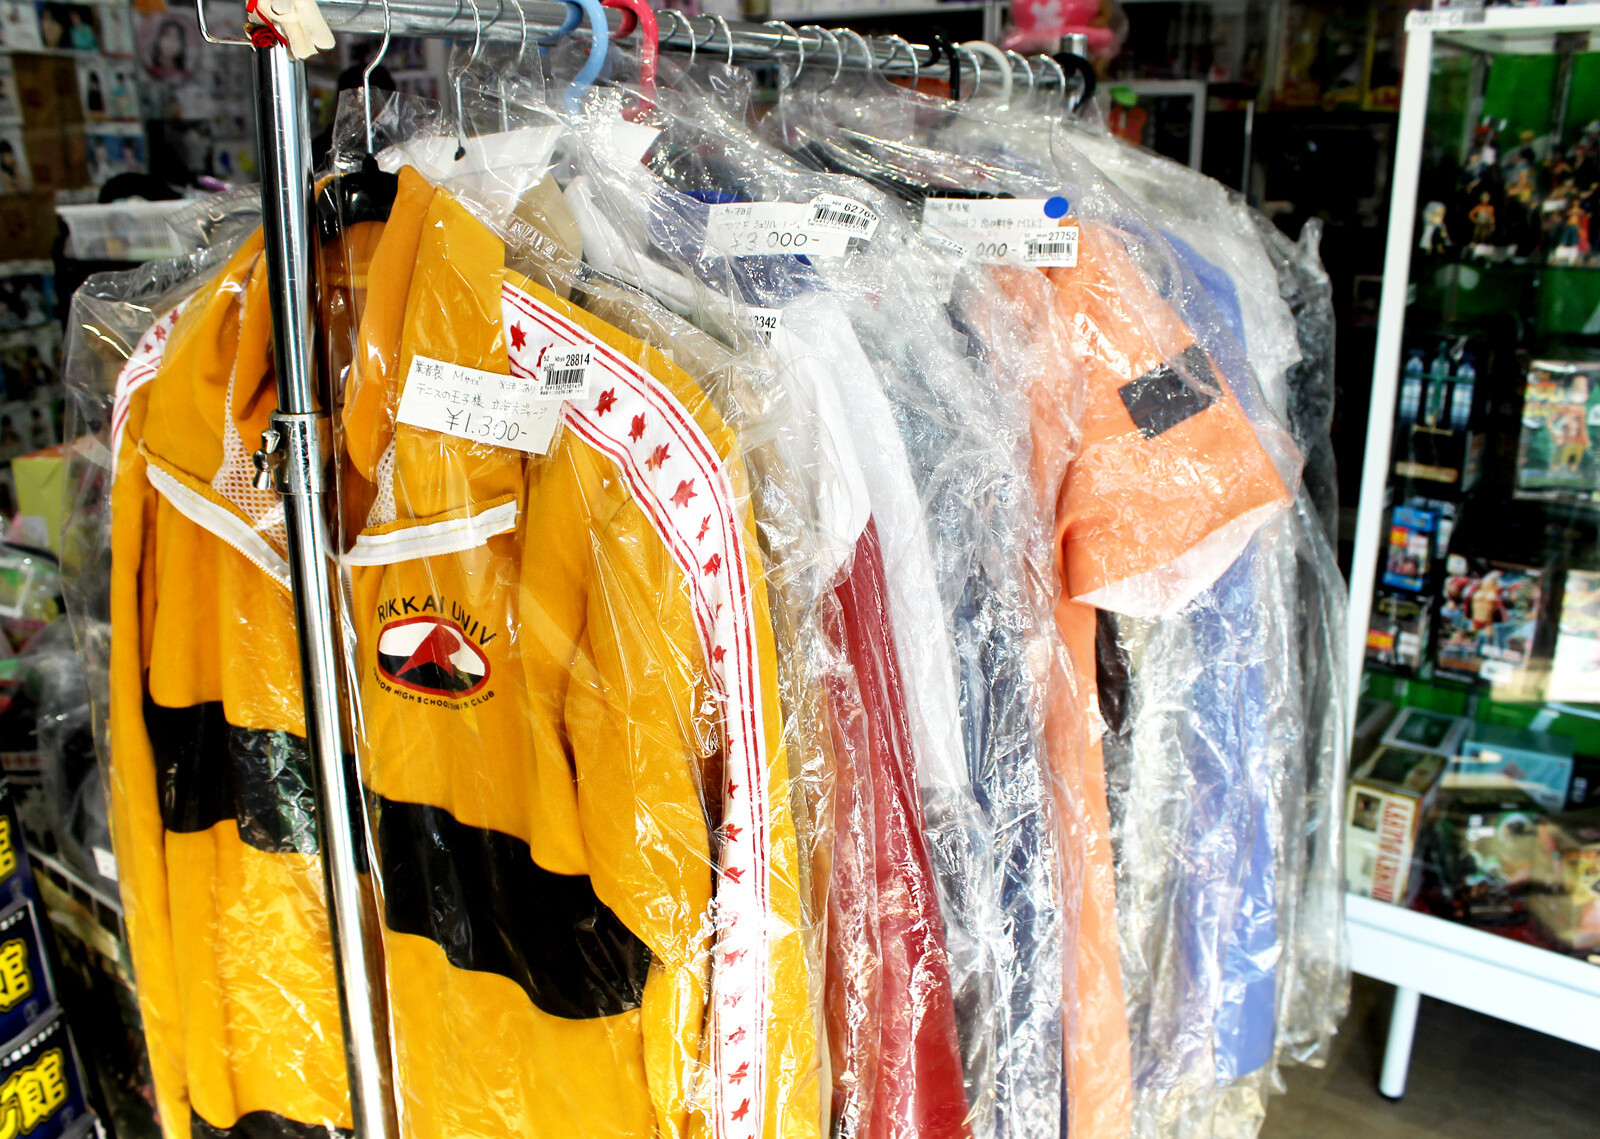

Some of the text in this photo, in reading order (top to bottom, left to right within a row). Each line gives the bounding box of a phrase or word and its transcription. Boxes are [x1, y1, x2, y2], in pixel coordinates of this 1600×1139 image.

[844, 202, 877, 221] 62769
[1048, 231, 1077, 241] 27752
[565, 352, 590, 367] 28814
[416, 382, 485, 409] テニスの王子様
[377, 594, 497, 645] RIKKAI UNIV
[394, 689, 415, 701] HIGH
[470, 690, 495, 707] CLUB
